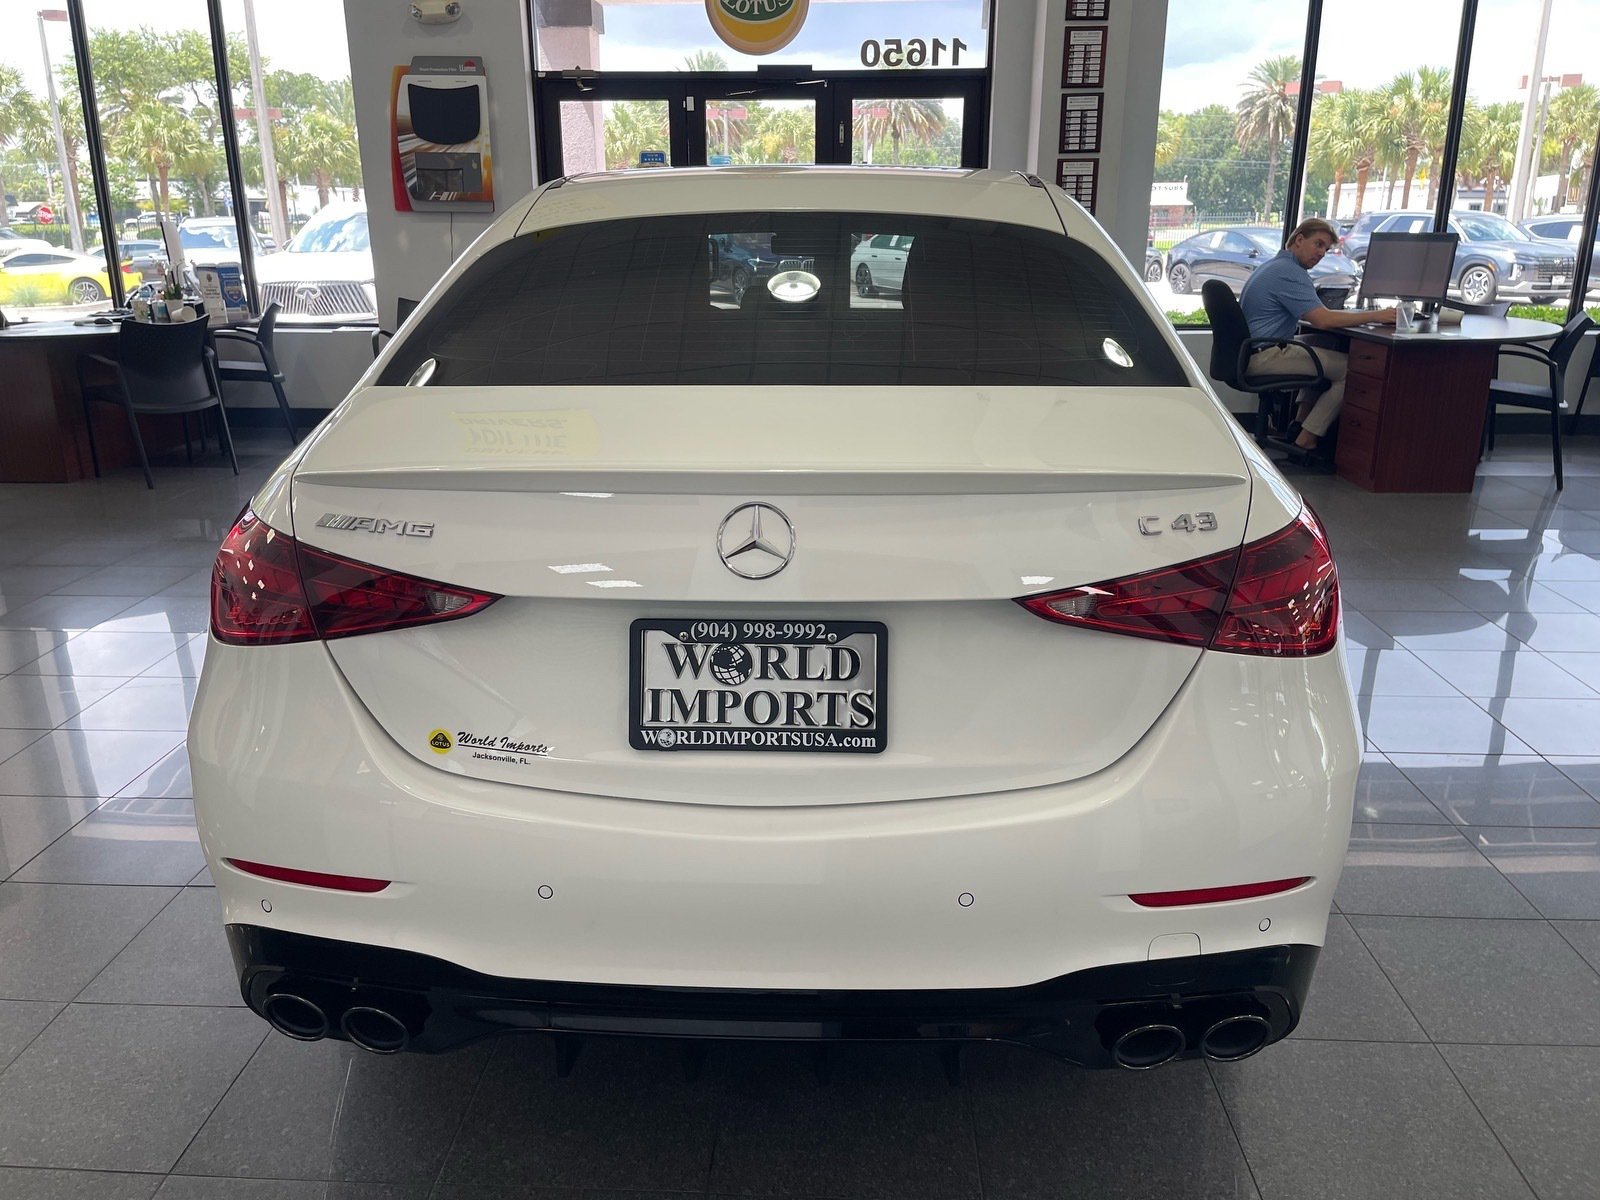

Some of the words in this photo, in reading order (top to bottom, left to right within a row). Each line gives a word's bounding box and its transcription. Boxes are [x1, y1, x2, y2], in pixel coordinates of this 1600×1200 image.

[1138, 515, 1162, 536] C
[1171, 511, 1218, 533] 43
[690, 622, 738, 642] (904)
[743, 623, 827, 641] 998-9992
[661, 642, 863, 687] WORLD
[645, 688, 877, 728] IMPORTS
[431, 740, 450, 748] LOTUS
[457, 731, 497, 747] World
[500, 736, 549, 754] Imports
[640, 730, 877, 749] WORLDIMPORTSUSA.com
[472, 751, 518, 765] Jacksonville,
